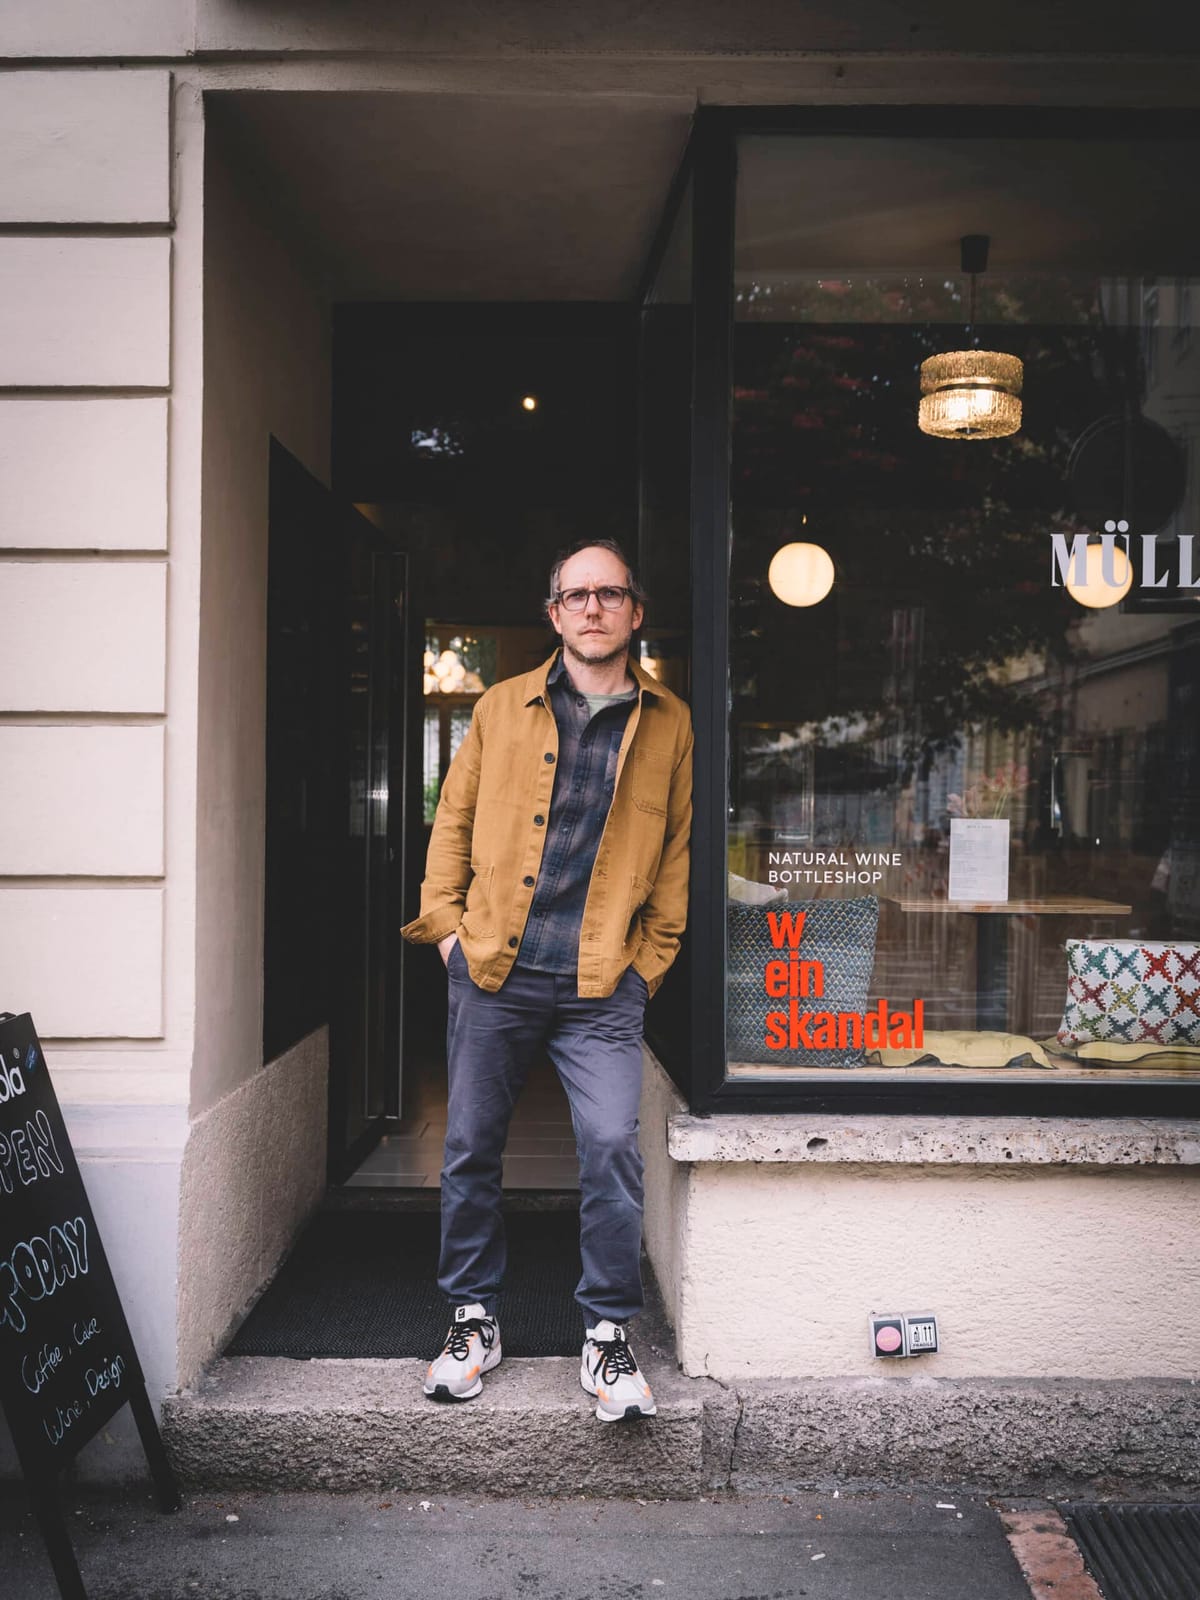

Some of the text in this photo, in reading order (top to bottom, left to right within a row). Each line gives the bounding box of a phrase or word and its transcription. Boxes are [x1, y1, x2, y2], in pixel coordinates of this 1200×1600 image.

[768, 852, 902, 866] NATURAL WINE
[768, 870, 882, 884] BOTTLESHOP
[765, 950, 824, 998] ein
[765, 998, 924, 1049] skandal
[0, 1053, 26, 1103] ola
[0, 1109, 64, 1194] PEN
[73, 1318, 101, 1345] Cake
[84, 1354, 126, 1396] Design
